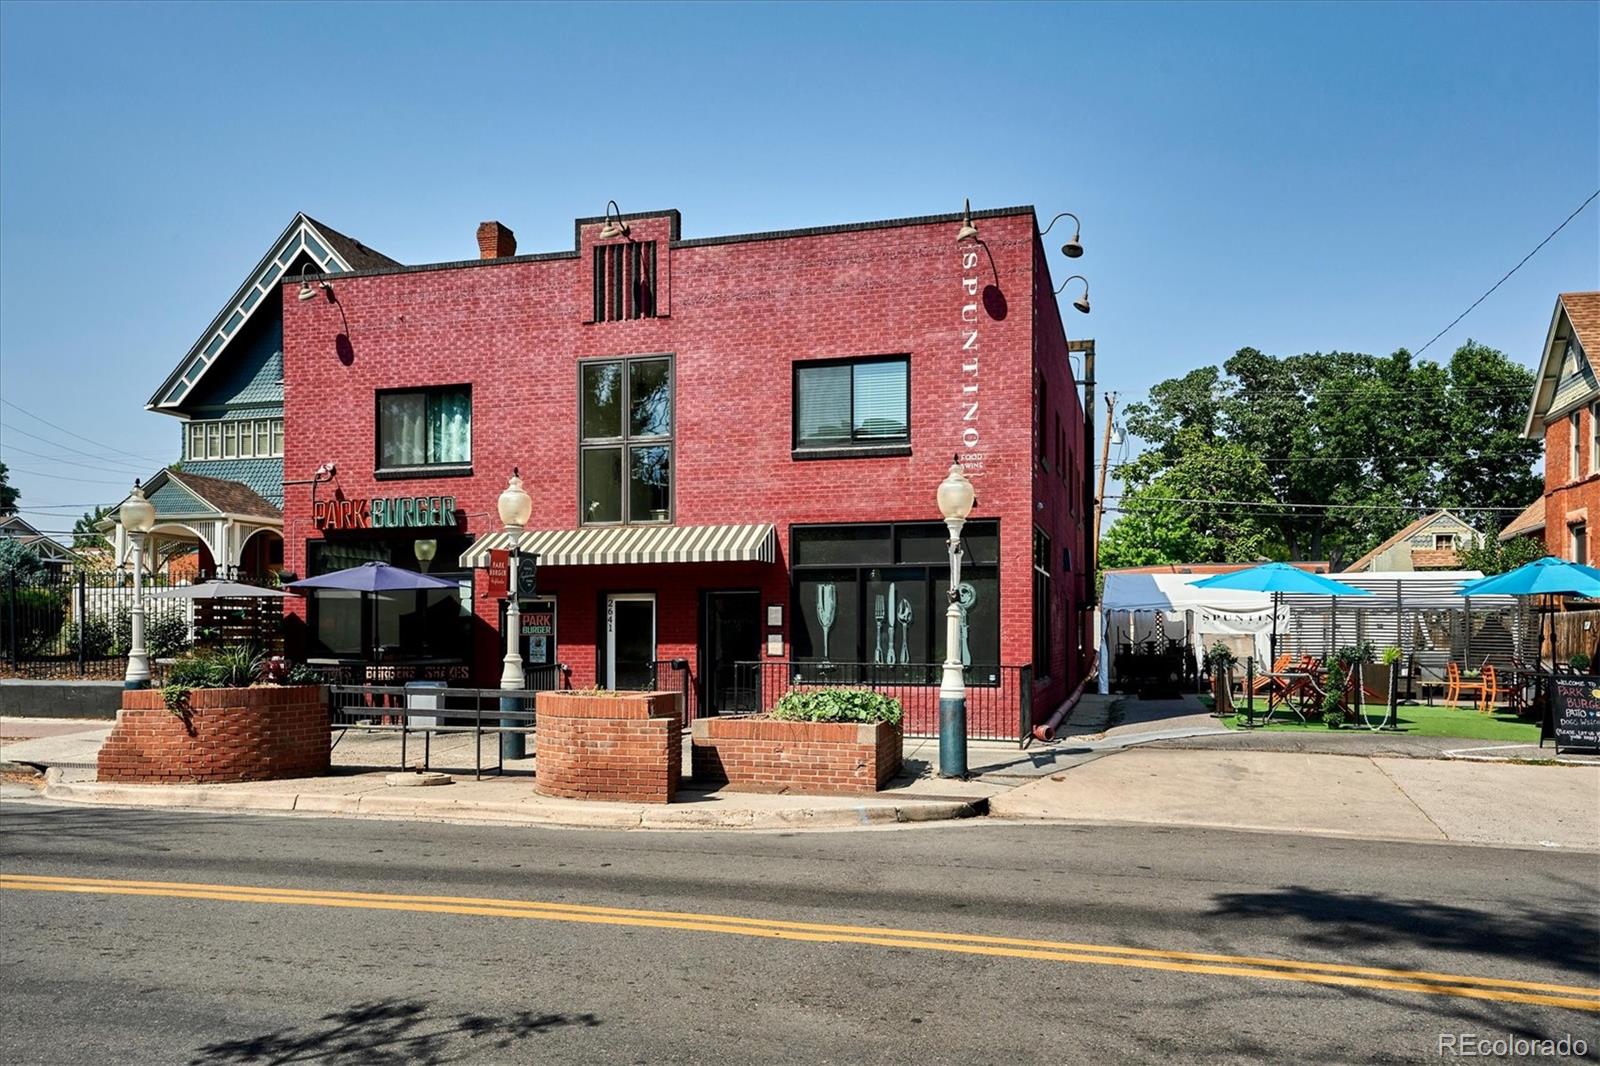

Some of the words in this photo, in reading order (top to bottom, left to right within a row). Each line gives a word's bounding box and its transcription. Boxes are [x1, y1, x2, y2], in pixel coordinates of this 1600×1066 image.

[962, 252, 978, 447] SPUNTINO
[960, 453, 983, 461] FOOD
[313, 500, 366, 529] PARK
[371, 495, 457, 528] BURGER
[522, 614, 551, 626] PARK
[522, 626, 551, 634] BURGER
[1557, 686, 1585, 697] PARK
[1566, 709, 1587, 717] PATIO
